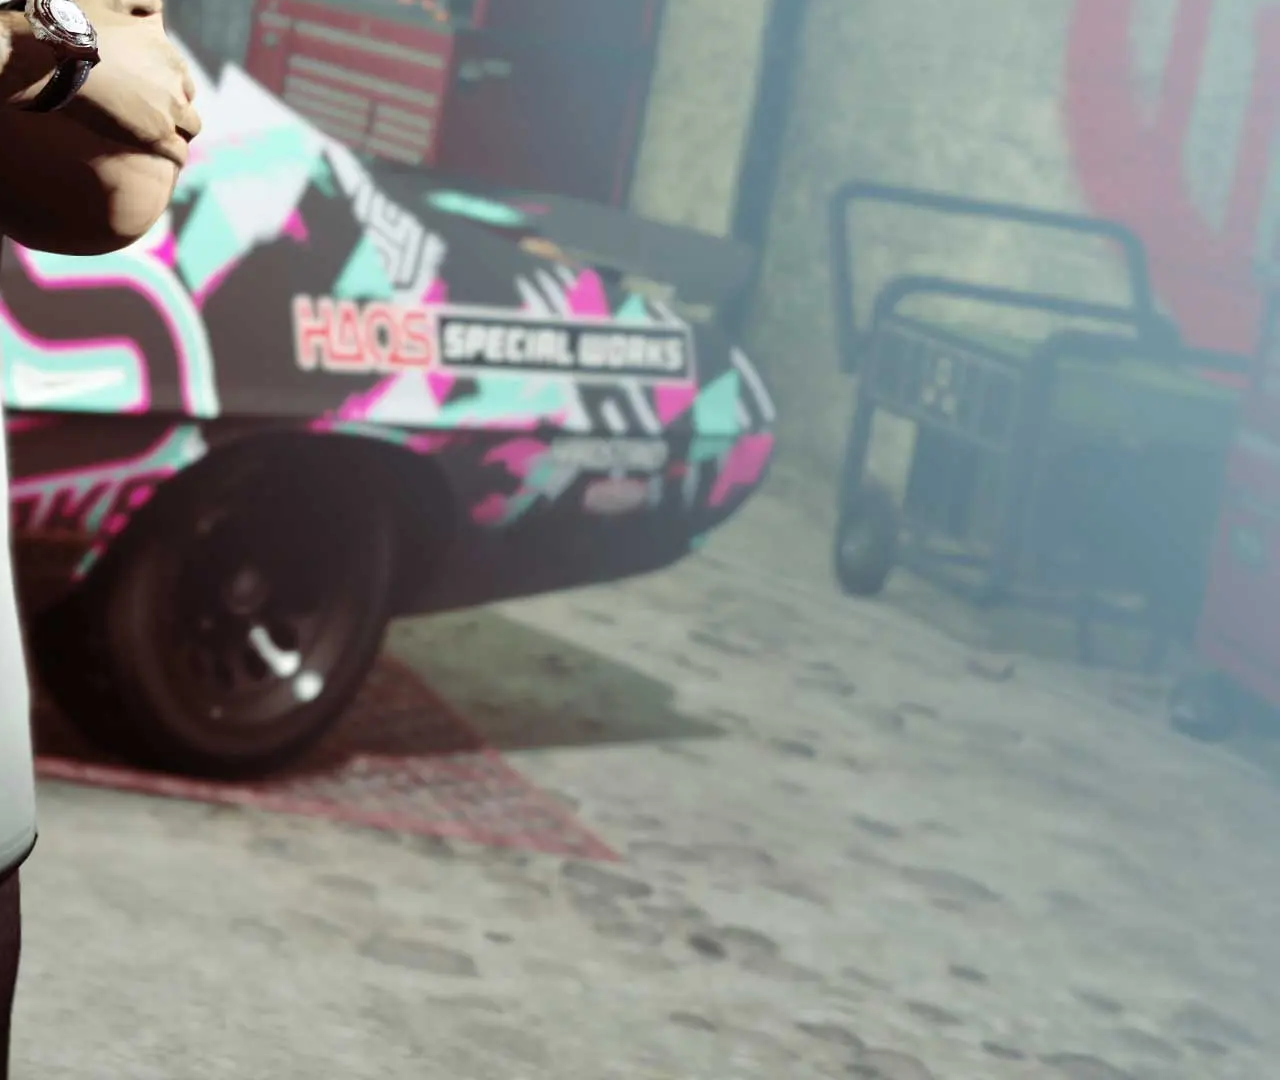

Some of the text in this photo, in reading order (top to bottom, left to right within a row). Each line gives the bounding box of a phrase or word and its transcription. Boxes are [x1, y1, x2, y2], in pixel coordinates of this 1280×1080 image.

[293, 299, 683, 370] HAOS SPECIAL WORKS
